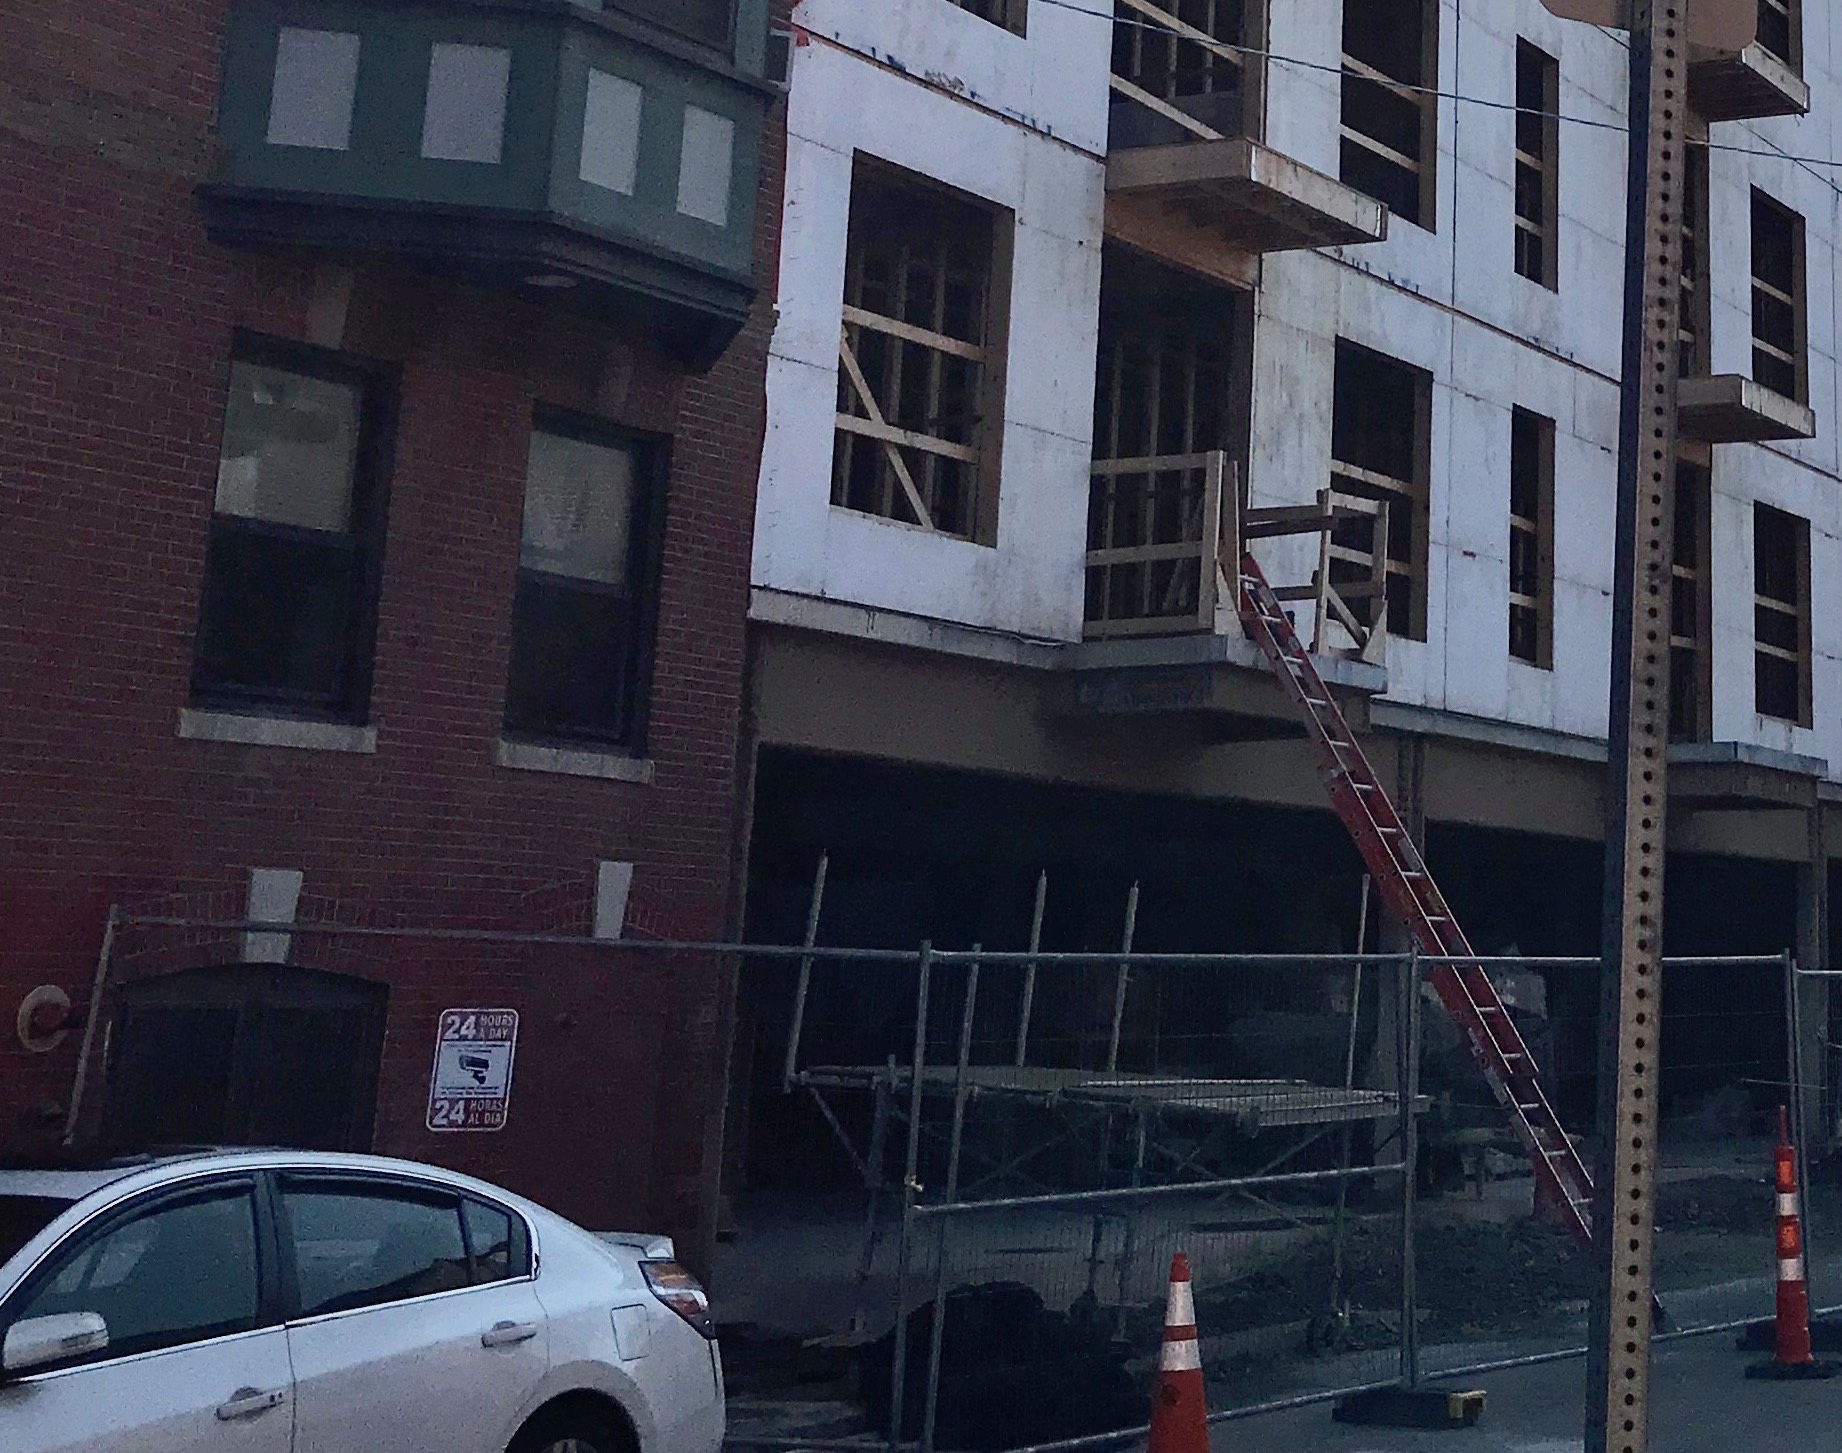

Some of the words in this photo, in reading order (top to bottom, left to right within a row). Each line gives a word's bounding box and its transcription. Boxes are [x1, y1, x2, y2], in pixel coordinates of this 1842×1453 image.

[480, 1014, 514, 1027] HOURS
[444, 1015, 477, 1040] 24
[489, 1028, 509, 1039] DAY
[470, 1100, 503, 1111] HORAS
[432, 1100, 465, 1125] 24
[467, 1113, 479, 1124] AL
[484, 1113, 502, 1124] DIA
